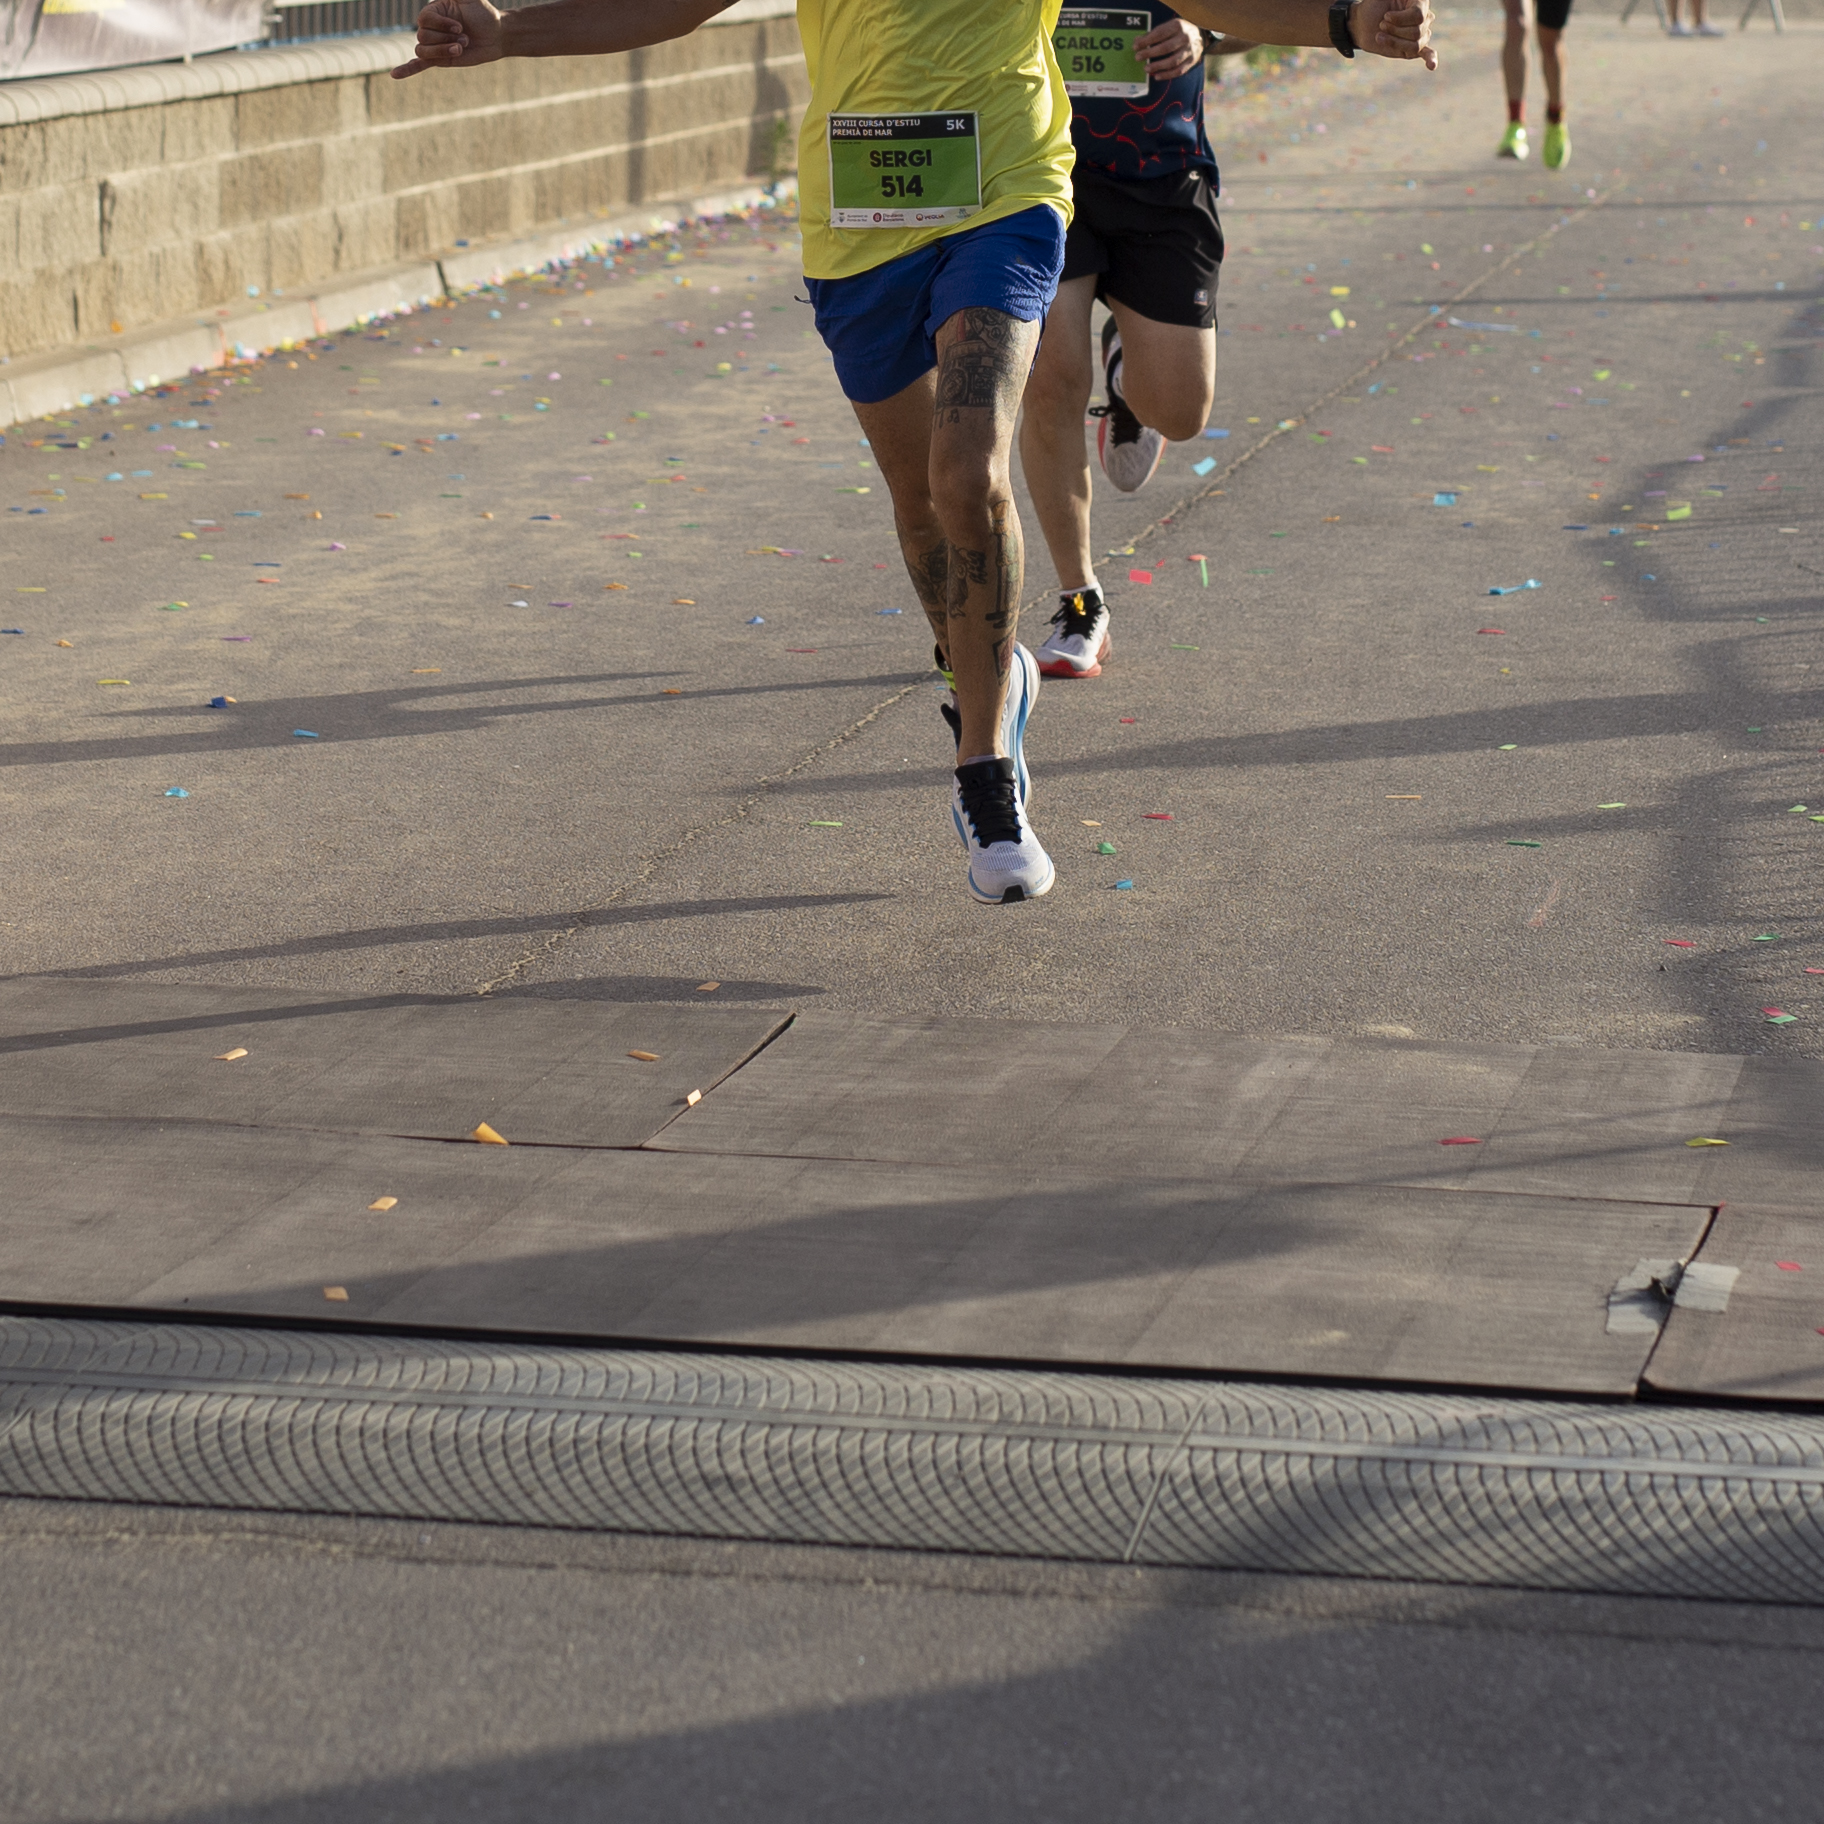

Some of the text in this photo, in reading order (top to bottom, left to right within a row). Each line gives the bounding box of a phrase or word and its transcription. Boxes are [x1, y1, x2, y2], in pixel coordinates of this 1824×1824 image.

[1126, 16, 1141, 26] 5K
[1055, 36, 1124, 51] CARLOS
[1071, 55, 1105, 73] 516
[832, 118, 965, 131] XXVIII CURSA D'ESTIU 5K
[832, 127, 862, 136] PREMIÀ
[870, 149, 932, 168] SERGI
[881, 175, 923, 198] 514
